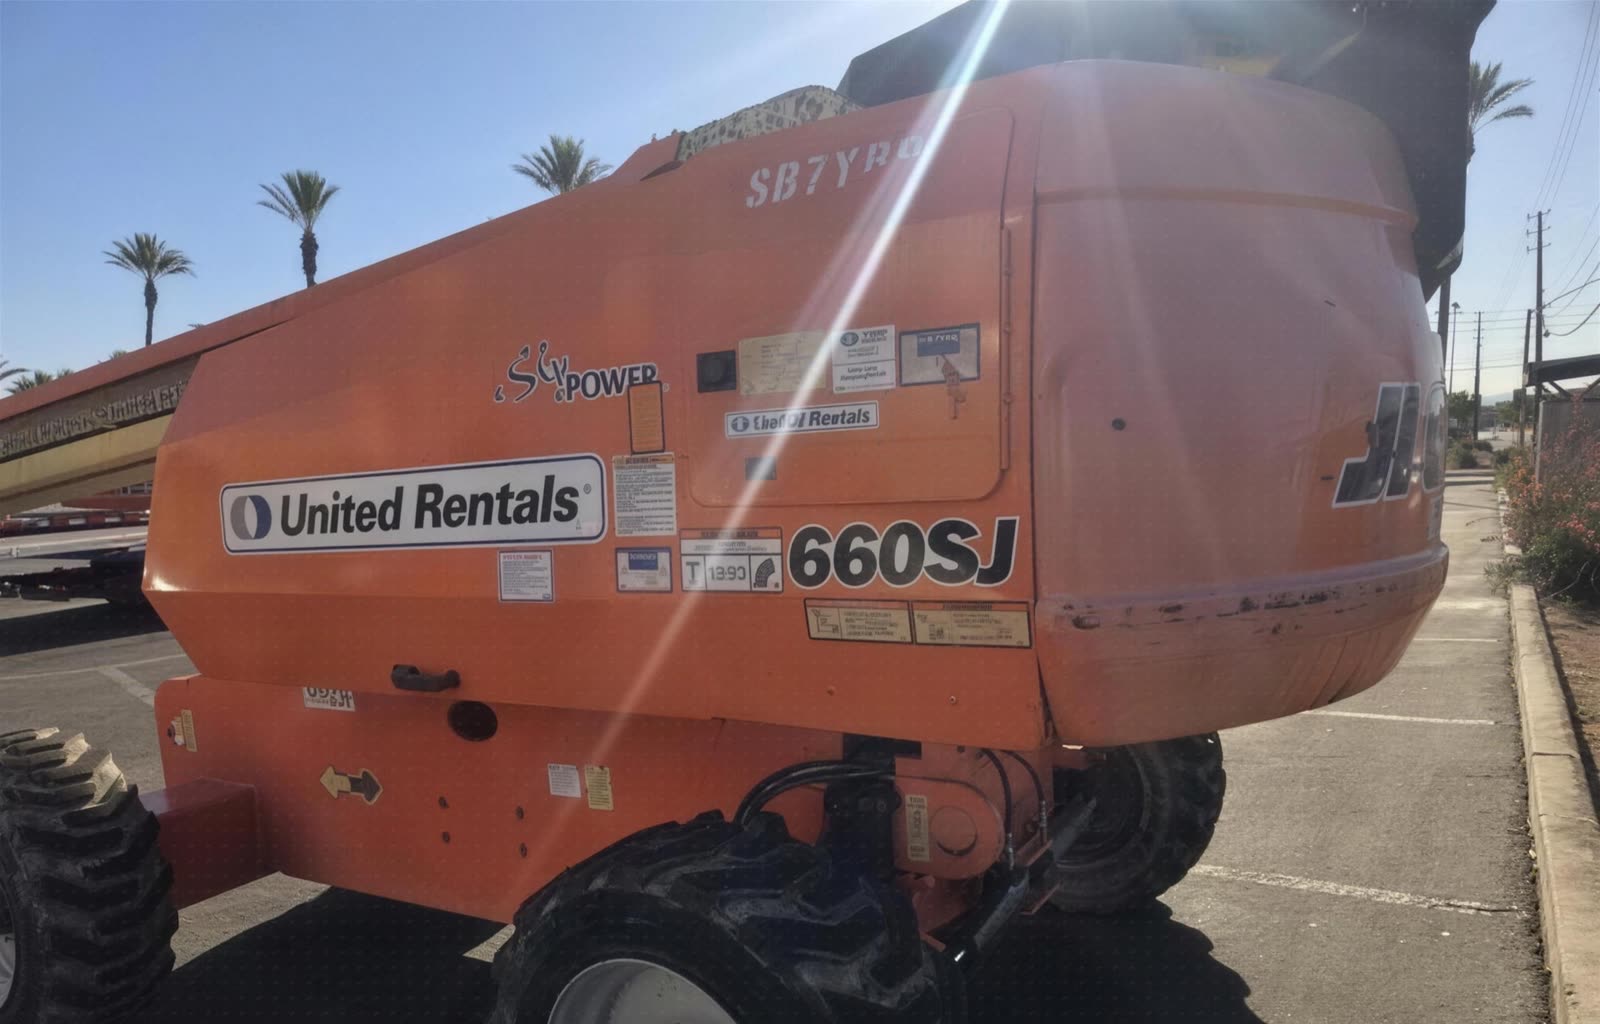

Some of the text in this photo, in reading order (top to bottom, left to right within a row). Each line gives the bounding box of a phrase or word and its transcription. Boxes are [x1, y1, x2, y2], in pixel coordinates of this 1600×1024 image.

[565, 362, 657, 402] POWER
[280, 485, 404, 537] United
[414, 474, 579, 529] Rentals
[787, 515, 1020, 590] 660SJ
